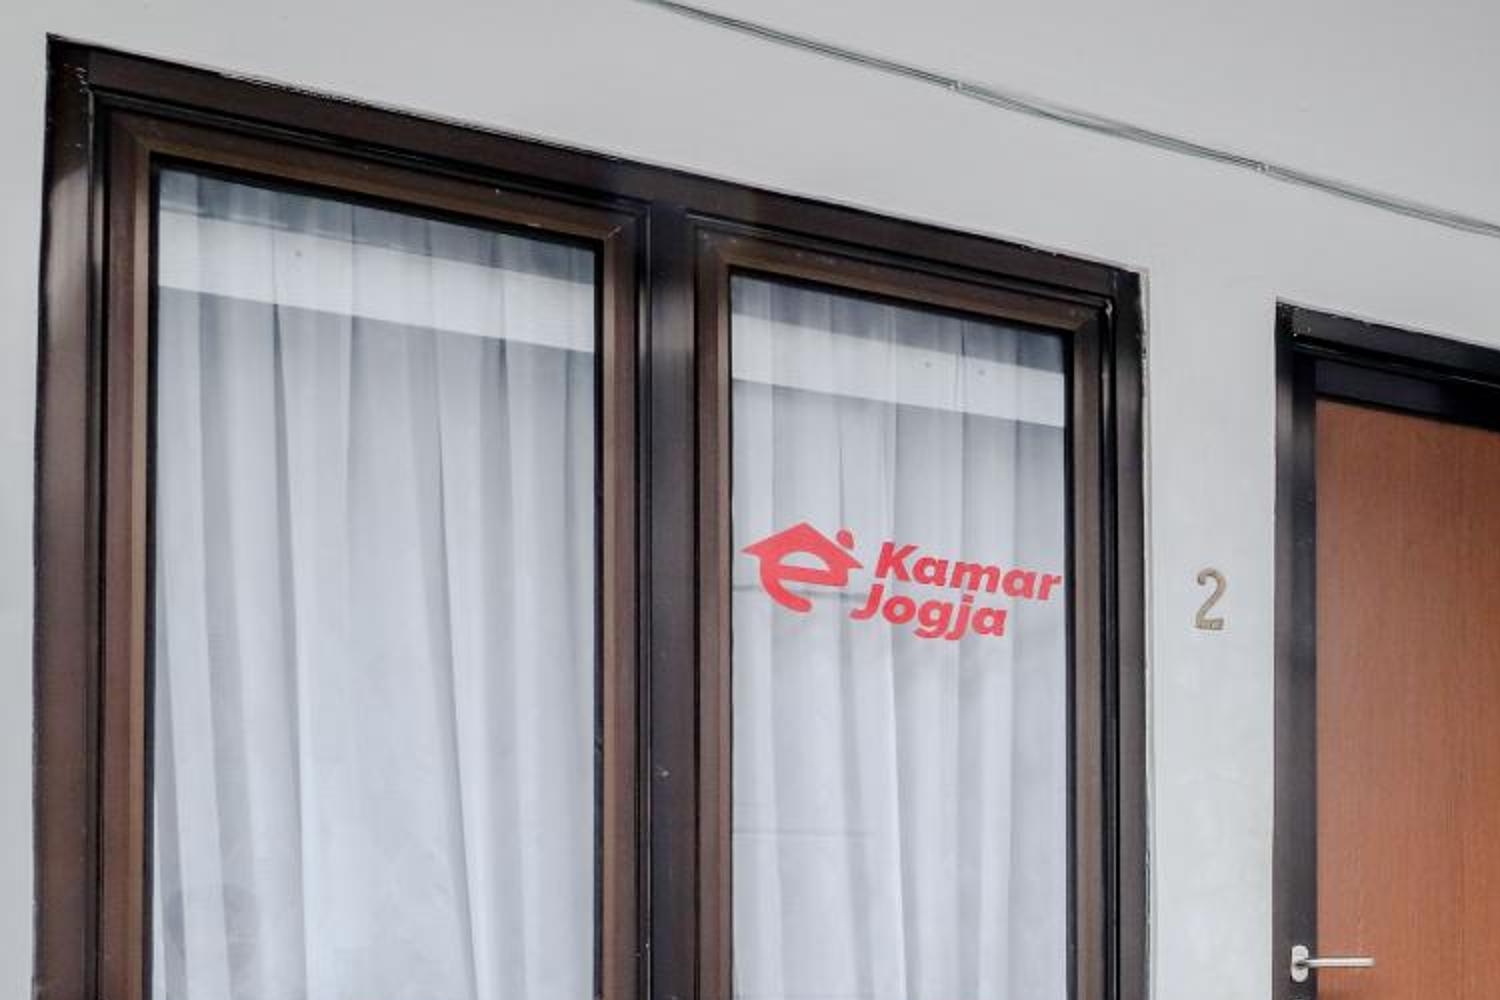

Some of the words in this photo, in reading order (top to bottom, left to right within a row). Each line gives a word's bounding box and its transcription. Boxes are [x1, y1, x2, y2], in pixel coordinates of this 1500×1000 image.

[874, 541, 1061, 601] Kamar
[1195, 567, 1227, 631] 2
[850, 583, 1008, 641] Jogja
